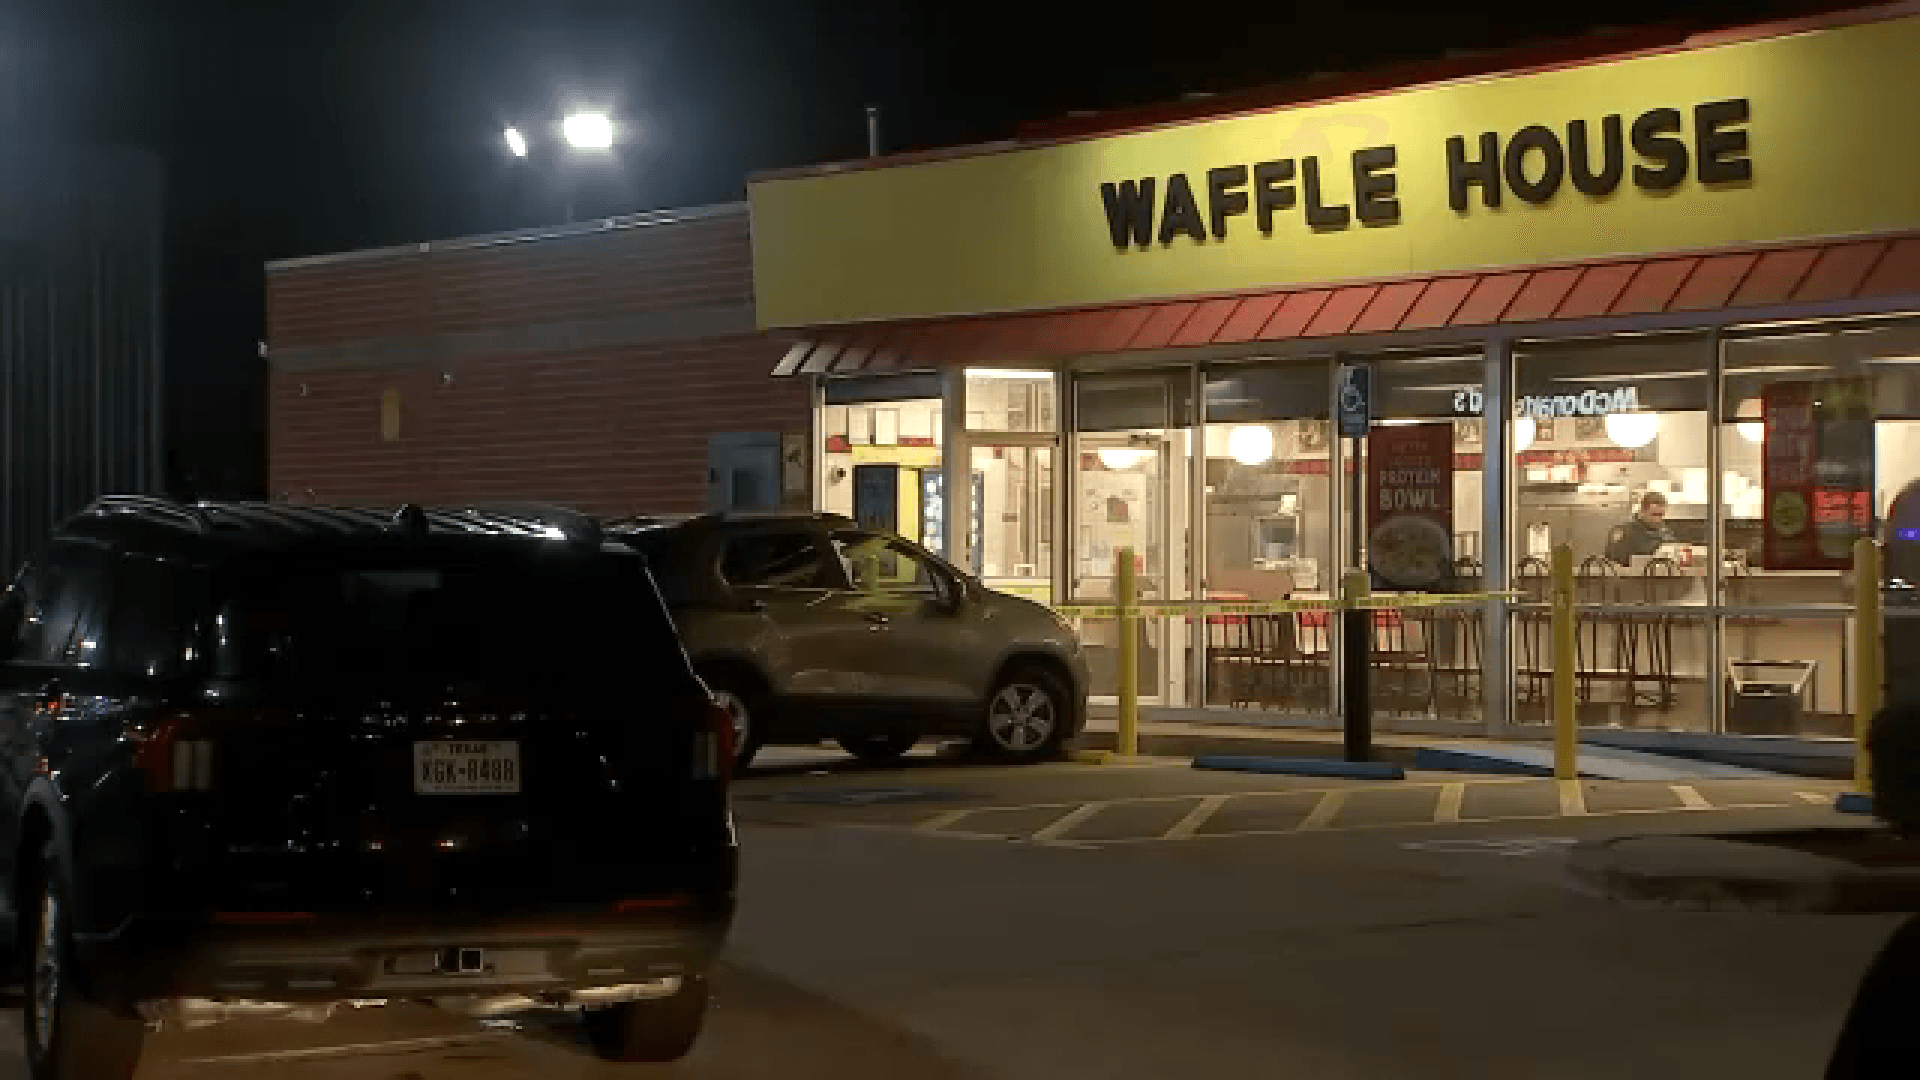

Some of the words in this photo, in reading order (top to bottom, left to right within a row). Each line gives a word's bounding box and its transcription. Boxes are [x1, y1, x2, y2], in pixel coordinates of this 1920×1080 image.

[1101, 145, 1400, 251] WAFFLE
[1446, 98, 1752, 213] HOUSE
[1379, 488, 1441, 511] BOWL
